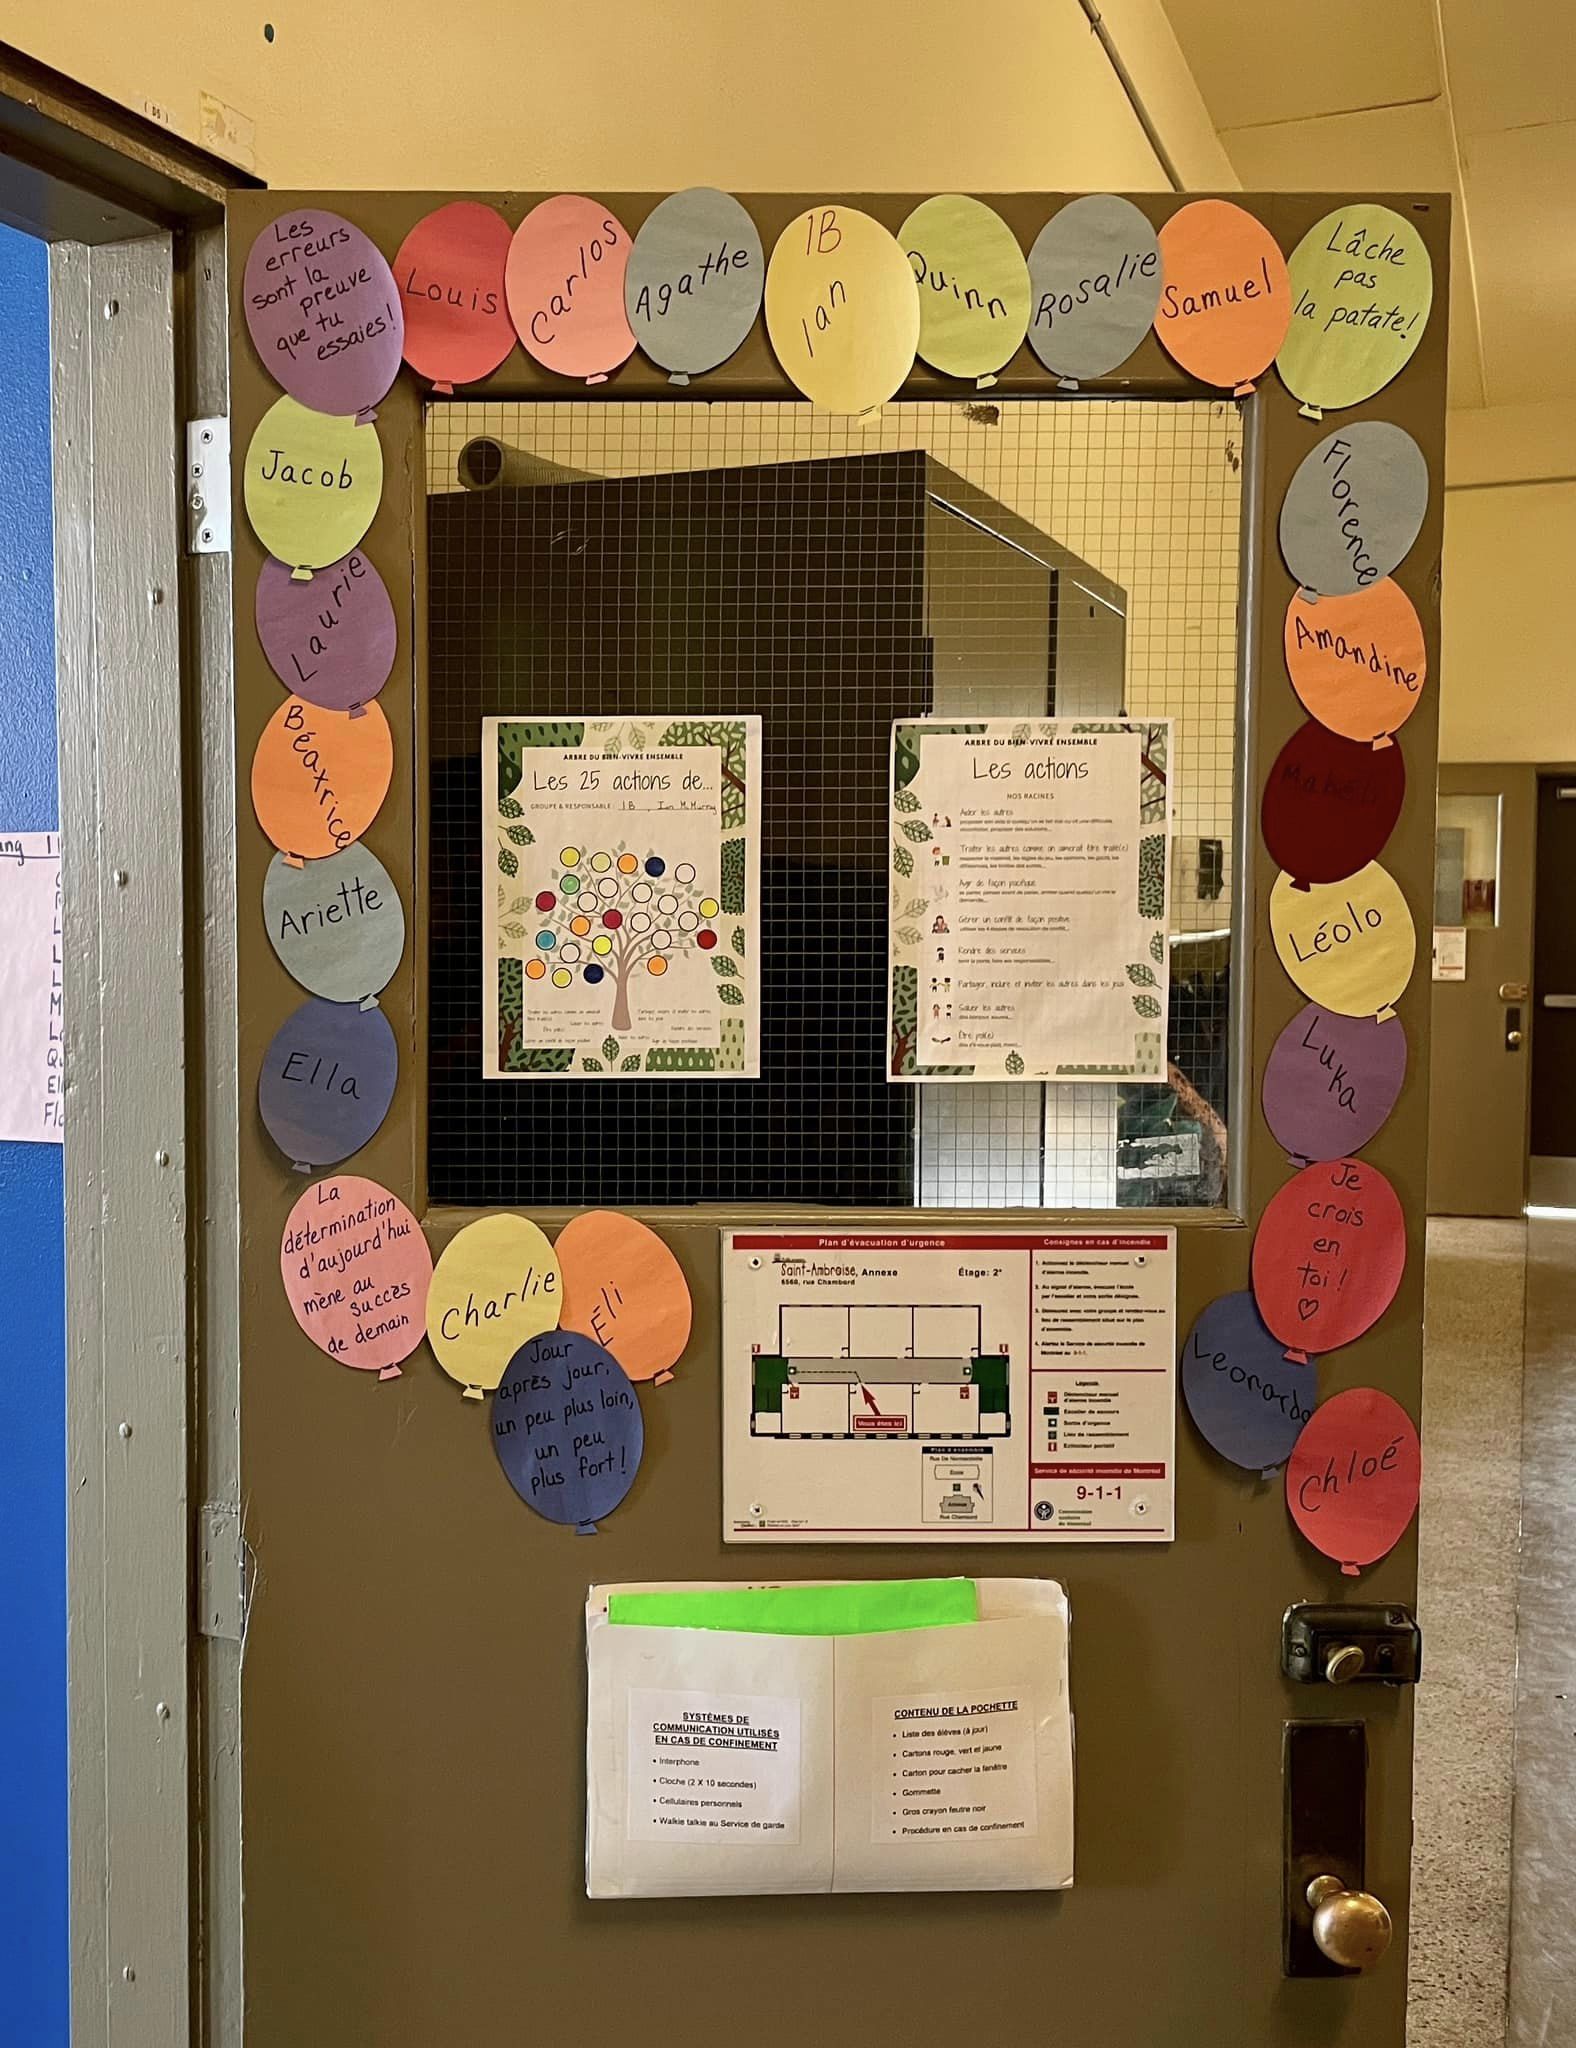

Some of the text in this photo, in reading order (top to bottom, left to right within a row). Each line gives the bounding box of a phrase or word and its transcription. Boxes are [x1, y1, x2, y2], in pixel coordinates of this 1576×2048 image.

[265, 227, 351, 273] erreurs
[274, 218, 315, 243] Les
[805, 209, 843, 256] 1B
[1326, 220, 1408, 267] Lâche
[252, 262, 330, 310] sont la
[299, 265, 372, 316] preuve
[406, 267, 499, 315] Louis
[530, 218, 618, 345] Carlos
[634, 242, 751, 322] Agathe
[906, 250, 1008, 319] Quinn
[1035, 250, 1157, 329] Rosalie
[1161, 257, 1273, 320] Samuel
[1334, 267, 1378, 291] pas
[276, 306, 345, 361] que tu
[316, 303, 397, 361] essaies!
[801, 278, 847, 357] Ian
[1293, 287, 1421, 340] la patate!
[261, 448, 354, 490] Jacob
[1322, 439, 1378, 586] Florence
[291, 556, 367, 682] Laurie
[1295, 615, 1419, 692] Amandine
[563, 752, 684, 761] ARBRE DU BIEN-VIVRE ENSEMBLE
[1056, 738, 1098, 746] ENSEMBLE
[284, 705, 351, 849] Béatrice
[533, 769, 713, 791] Les 25 actions de...
[972, 756, 1089, 780] Les actions
[280, 877, 384, 939] Ariette
[1289, 901, 1382, 962] Léolo
[281, 1052, 361, 1100] Ella
[1301, 1015, 1357, 1114] Luka
[317, 1184, 341, 1205] La
[1331, 1162, 1362, 1191] Je
[284, 1196, 397, 1254] détermination
[1307, 1202, 1364, 1227] crois
[299, 1218, 412, 1279] d'aujourd'hui
[818, 1238, 946, 1249] Plan d'évacuation d'urgence
[1312, 1236, 1341, 1256] en
[781, 1262, 898, 1277] Saint-Ambroise, Annexe
[958, 1266, 990, 1278] Étage:
[303, 1276, 376, 1316] mène au
[350, 1280, 412, 1318] succès
[440, 1266, 556, 1342] Charlie
[590, 1280, 623, 1348] Éli
[327, 1312, 410, 1355] de demain
[529, 1340, 574, 1364] Jour
[499, 1373, 552, 1400] après
[1194, 1332, 1313, 1424] Leonardo
[495, 1388, 634, 1437] un peu plus loin,
[534, 1431, 606, 1463] un peu
[530, 1465, 565, 1496] plus
[1076, 1485, 1122, 1500] 9-1-1
[1300, 1435, 1405, 1513] Chloé
[683, 1712, 749, 1726] SYSTÈMES DE
[894, 1700, 1018, 1719] CONTENU DE LA POCHETTE
[653, 1723, 780, 1739] COMMUNICATION UTILISÉS
[655, 1735, 778, 1751] EN CAS DE CONFINEMENT
[902, 1730, 920, 1739] Liste
[921, 1729, 935, 1738] des
[659, 1757, 700, 1767] Interphone
[902, 1749, 932, 1759] Cartons
[958, 1746, 973, 1755] vert
[982, 1744, 1002, 1755] jaune
[659, 1777, 686, 1786] Cloche
[687, 1778, 696, 1787] (2
[706, 1779, 716, 1787] 10
[717, 1780, 757, 1790] secondes)
[902, 1769, 927, 1778] Carton
[928, 1768, 947, 1778] pour
[659, 1796, 743, 1809] Cellulaires personnels
[902, 1808, 920, 1816] Gros
[922, 1807, 947, 1817] crayon
[659, 1817, 685, 1826] Walkie
[686, 1818, 707, 1827] talkie
[720, 1819, 749, 1829] Service
[751, 1821, 761, 1829] de
[762, 1821, 785, 1830] garde
[942, 1826, 952, 1834] en
[953, 1825, 967, 1833] cas
[968, 1823, 978, 1832] de
[979, 1821, 1025, 1833] confinement
